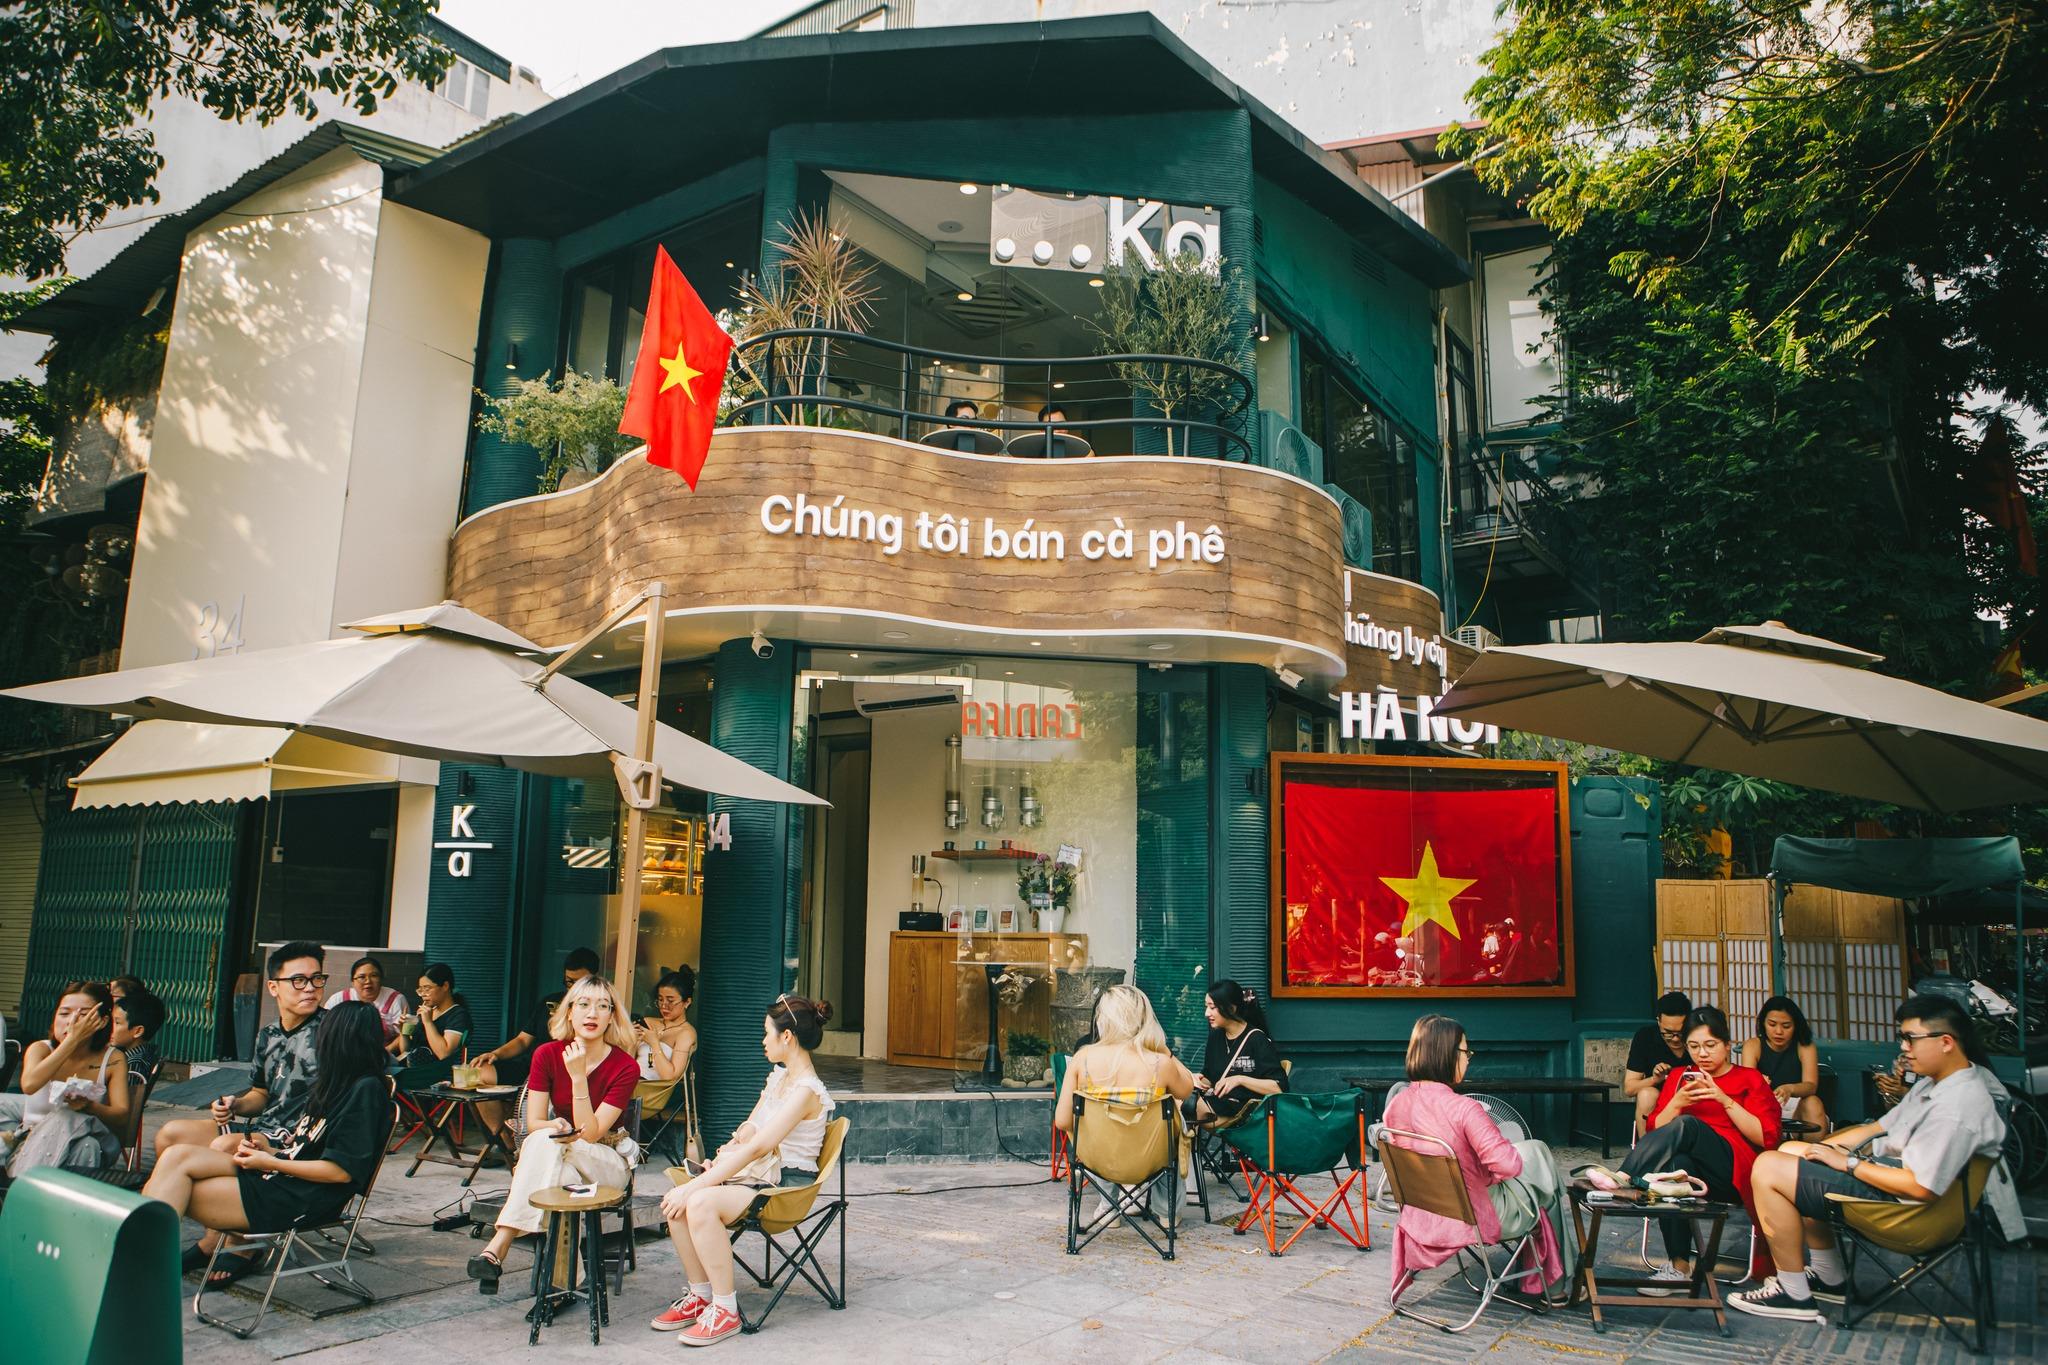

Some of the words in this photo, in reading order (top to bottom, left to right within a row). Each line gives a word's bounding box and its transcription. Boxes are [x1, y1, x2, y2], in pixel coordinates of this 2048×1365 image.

[760, 493, 902, 555] Chúng
[915, 511, 969, 555] tôi
[983, 516, 1064, 560] bán
[1080, 517, 1133, 560] cà
[1149, 520, 1225, 569] phê
[1344, 611, 1402, 661] hững
[1341, 684, 1407, 741] HÀ
[451, 804, 477, 839] K
